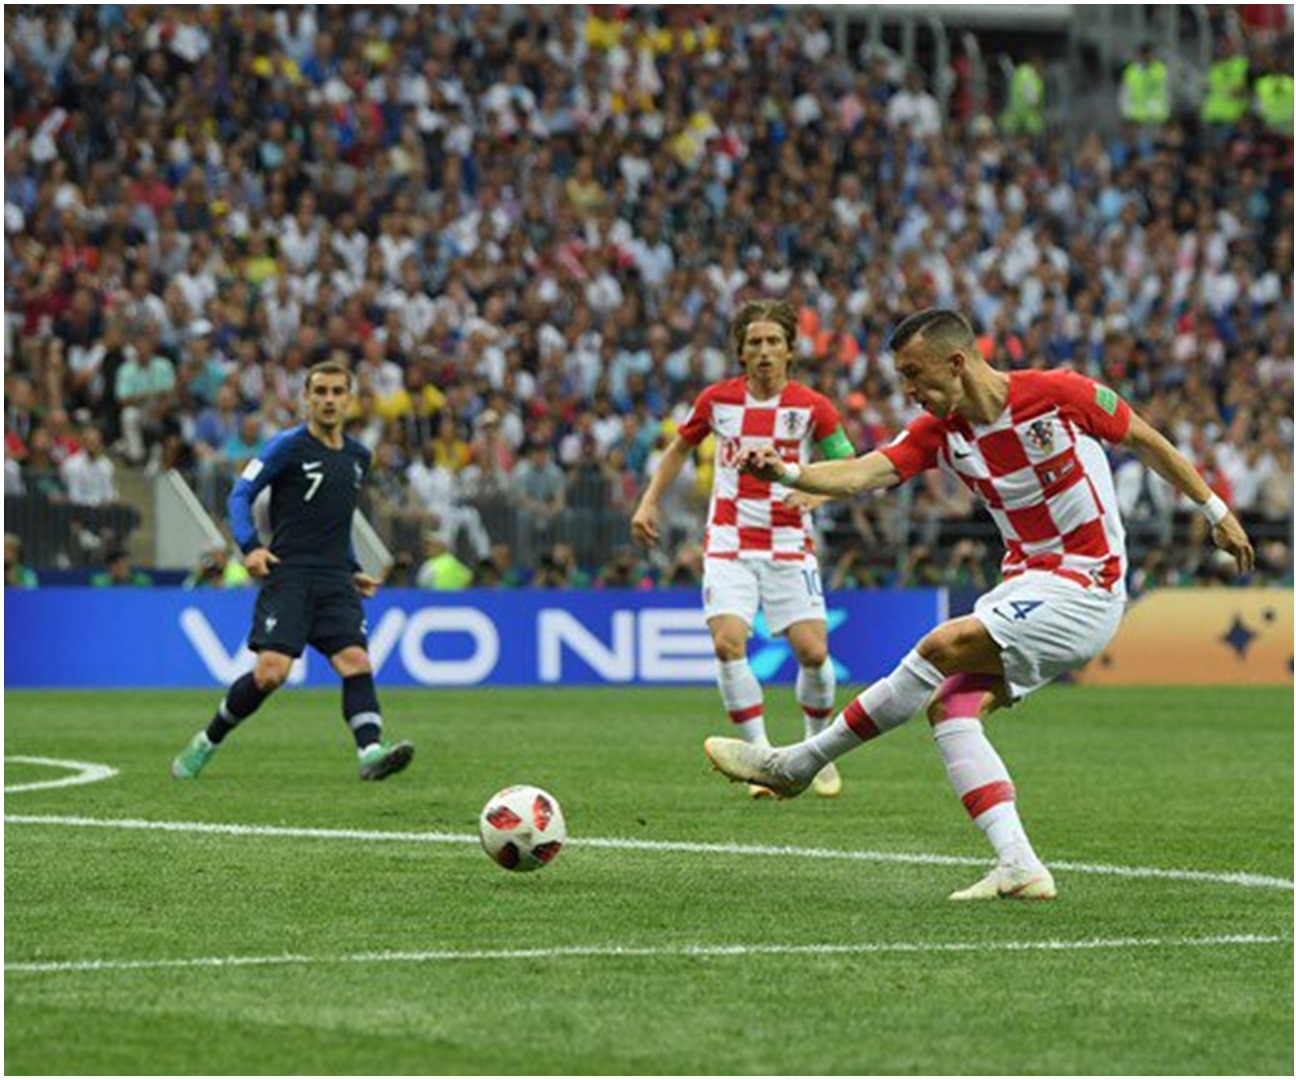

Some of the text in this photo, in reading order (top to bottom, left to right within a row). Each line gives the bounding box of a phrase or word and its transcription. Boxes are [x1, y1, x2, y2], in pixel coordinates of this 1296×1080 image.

[303, 472, 324, 502] 7
[1009, 600, 1044, 620] 4
[179, 606, 500, 686] VVO
